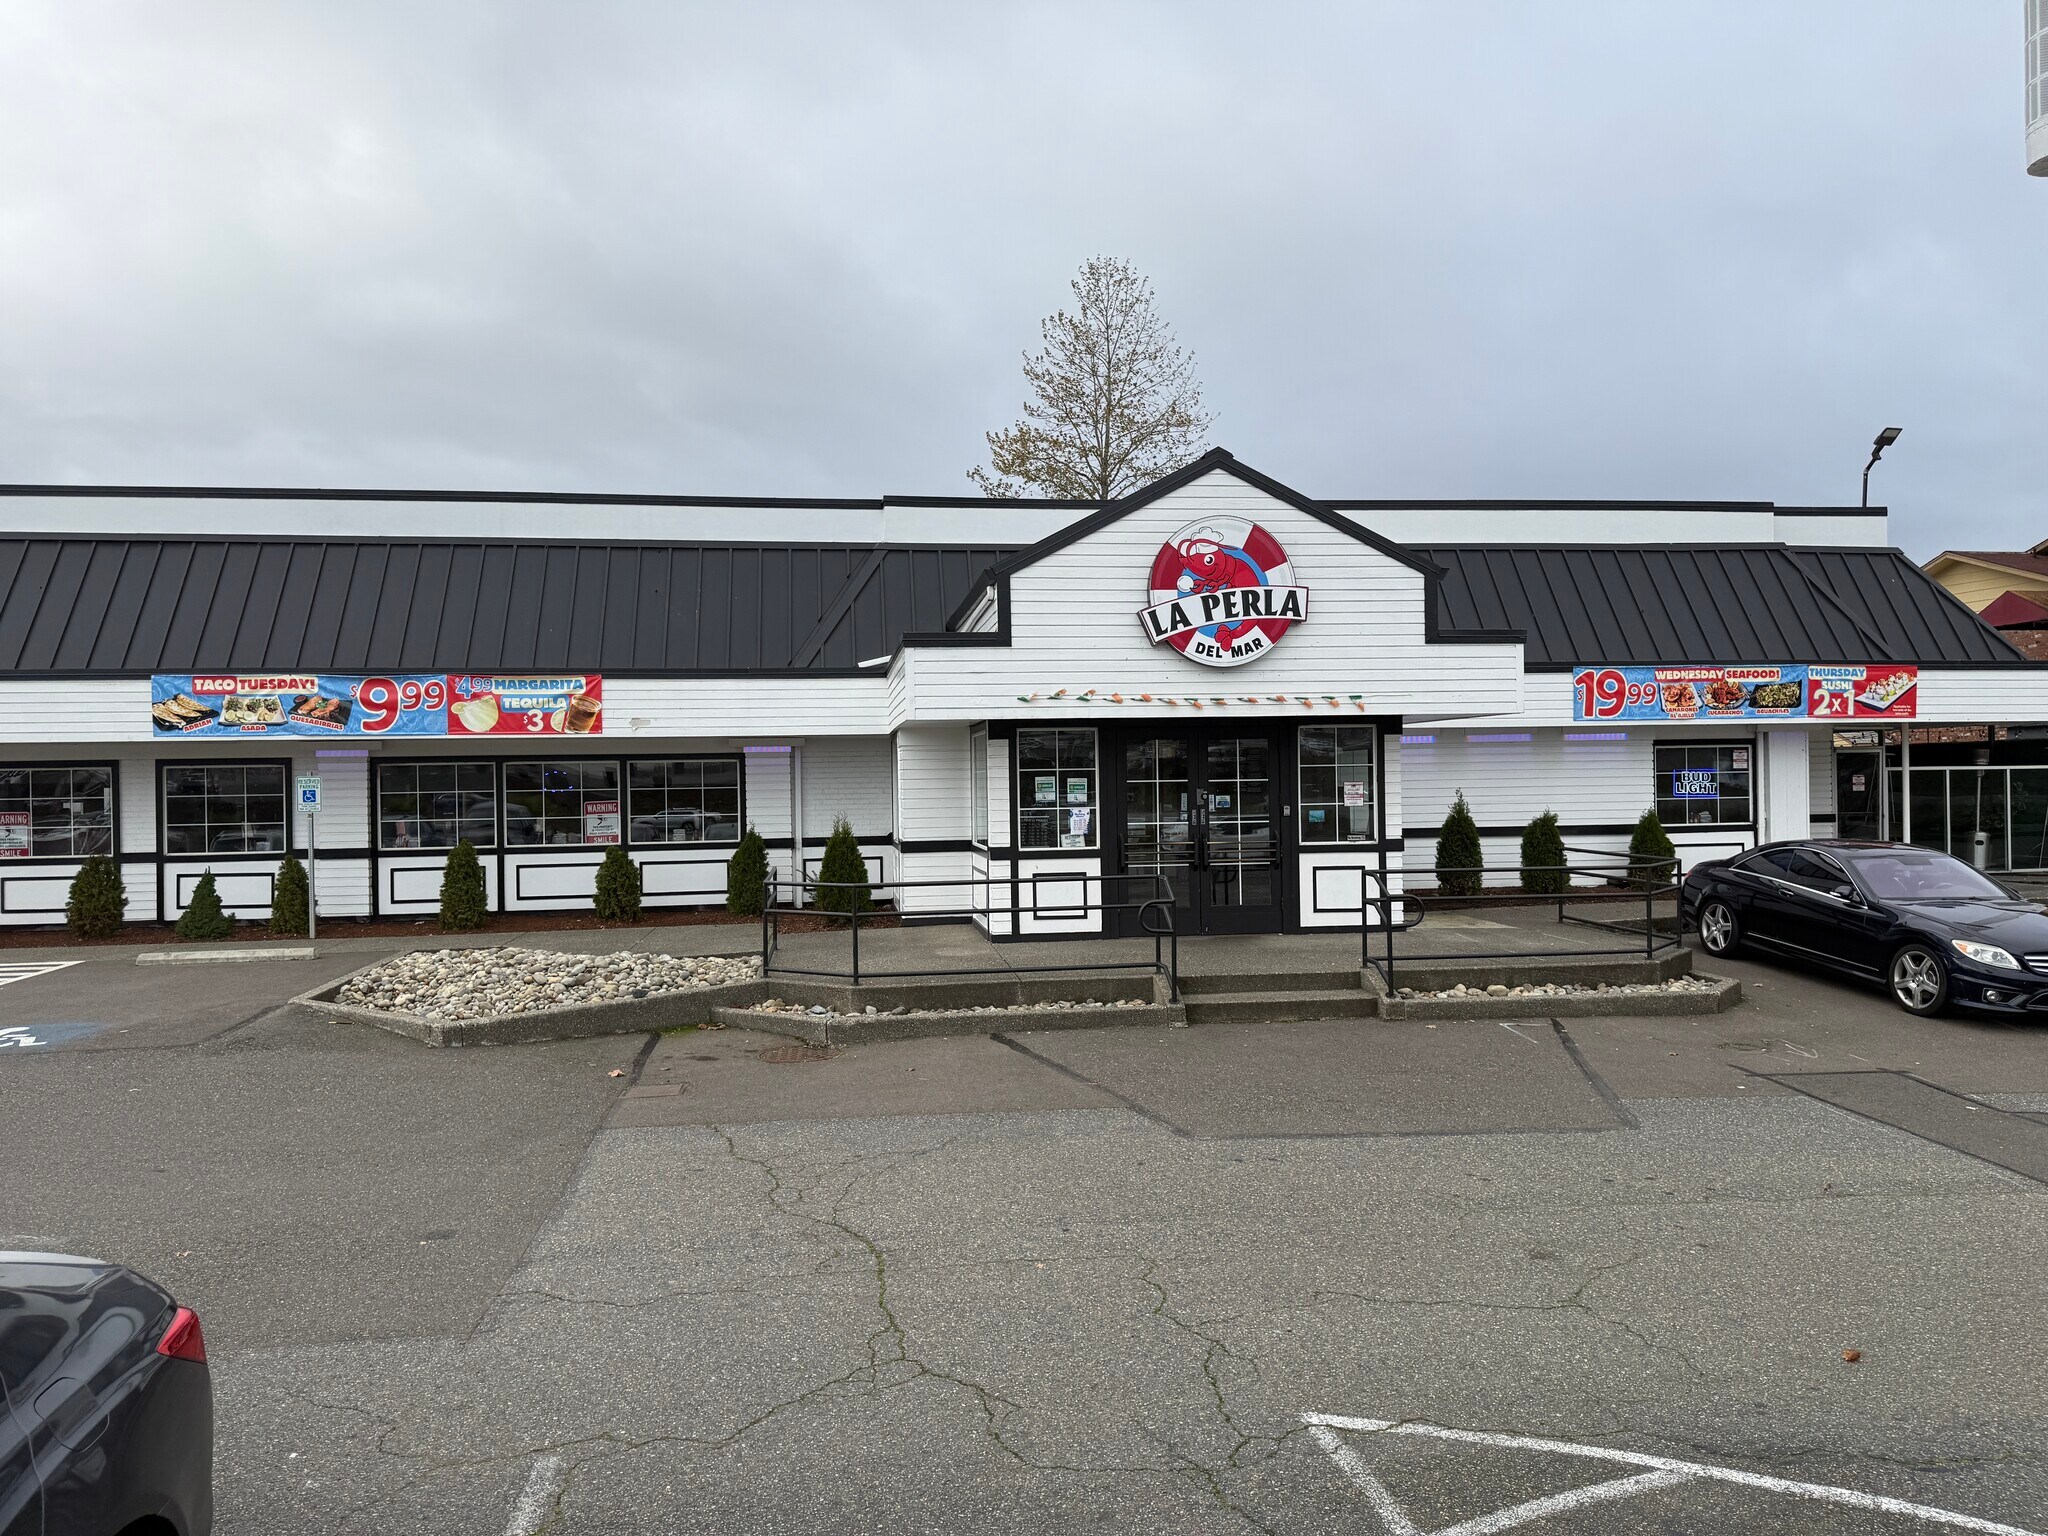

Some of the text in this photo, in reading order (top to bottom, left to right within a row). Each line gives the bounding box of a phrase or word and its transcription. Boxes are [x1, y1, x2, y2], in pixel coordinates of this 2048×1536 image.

[1147, 589, 1303, 637] LA PERLA
[1195, 637, 1264, 658] DEL MAR
[1655, 669, 1780, 680] WEDNESDAY SEAFOOD!
[1809, 668, 1866, 677] THURSDAY
[194, 677, 316, 691] TACO TUESDAY!
[494, 678, 584, 690] MARGARITA
[1821, 680, 1852, 690] SUSHI
[503, 697, 567, 708] TEQUILA
[183, 719, 213, 732] ADRIAN
[290, 715, 344, 731] QUESABIRRIAS
[523, 709, 544, 731] $3
[1681, 771, 1712, 783] BUD
[1675, 782, 1717, 794] LIGHT
[587, 803, 617, 813] WARNING
[0, 814, 27, 824] ARNING
[0, 849, 21, 857] SMILE
